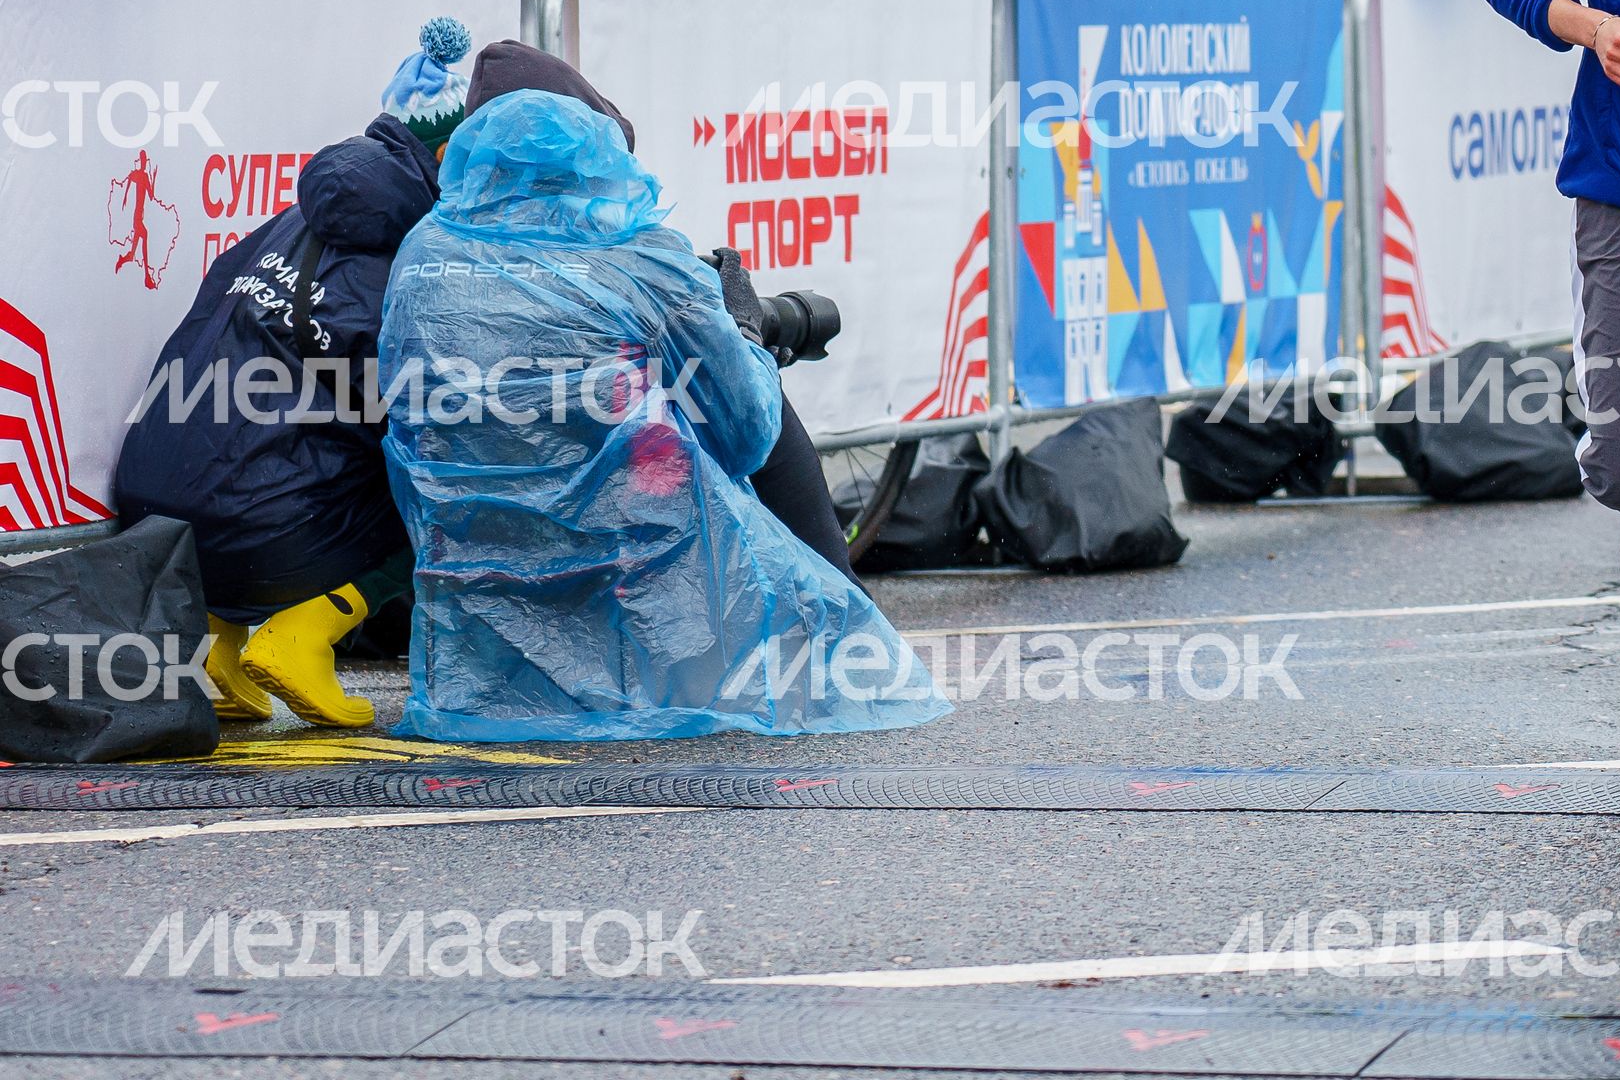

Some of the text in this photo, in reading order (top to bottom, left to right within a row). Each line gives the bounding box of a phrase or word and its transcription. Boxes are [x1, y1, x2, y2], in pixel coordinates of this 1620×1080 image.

[725, 107, 888, 184] МОСОБЛ
[1448, 105, 1571, 181] самоле
[401, 261, 590, 279] PORSCHE
[727, 194, 859, 272] СПОРТ
